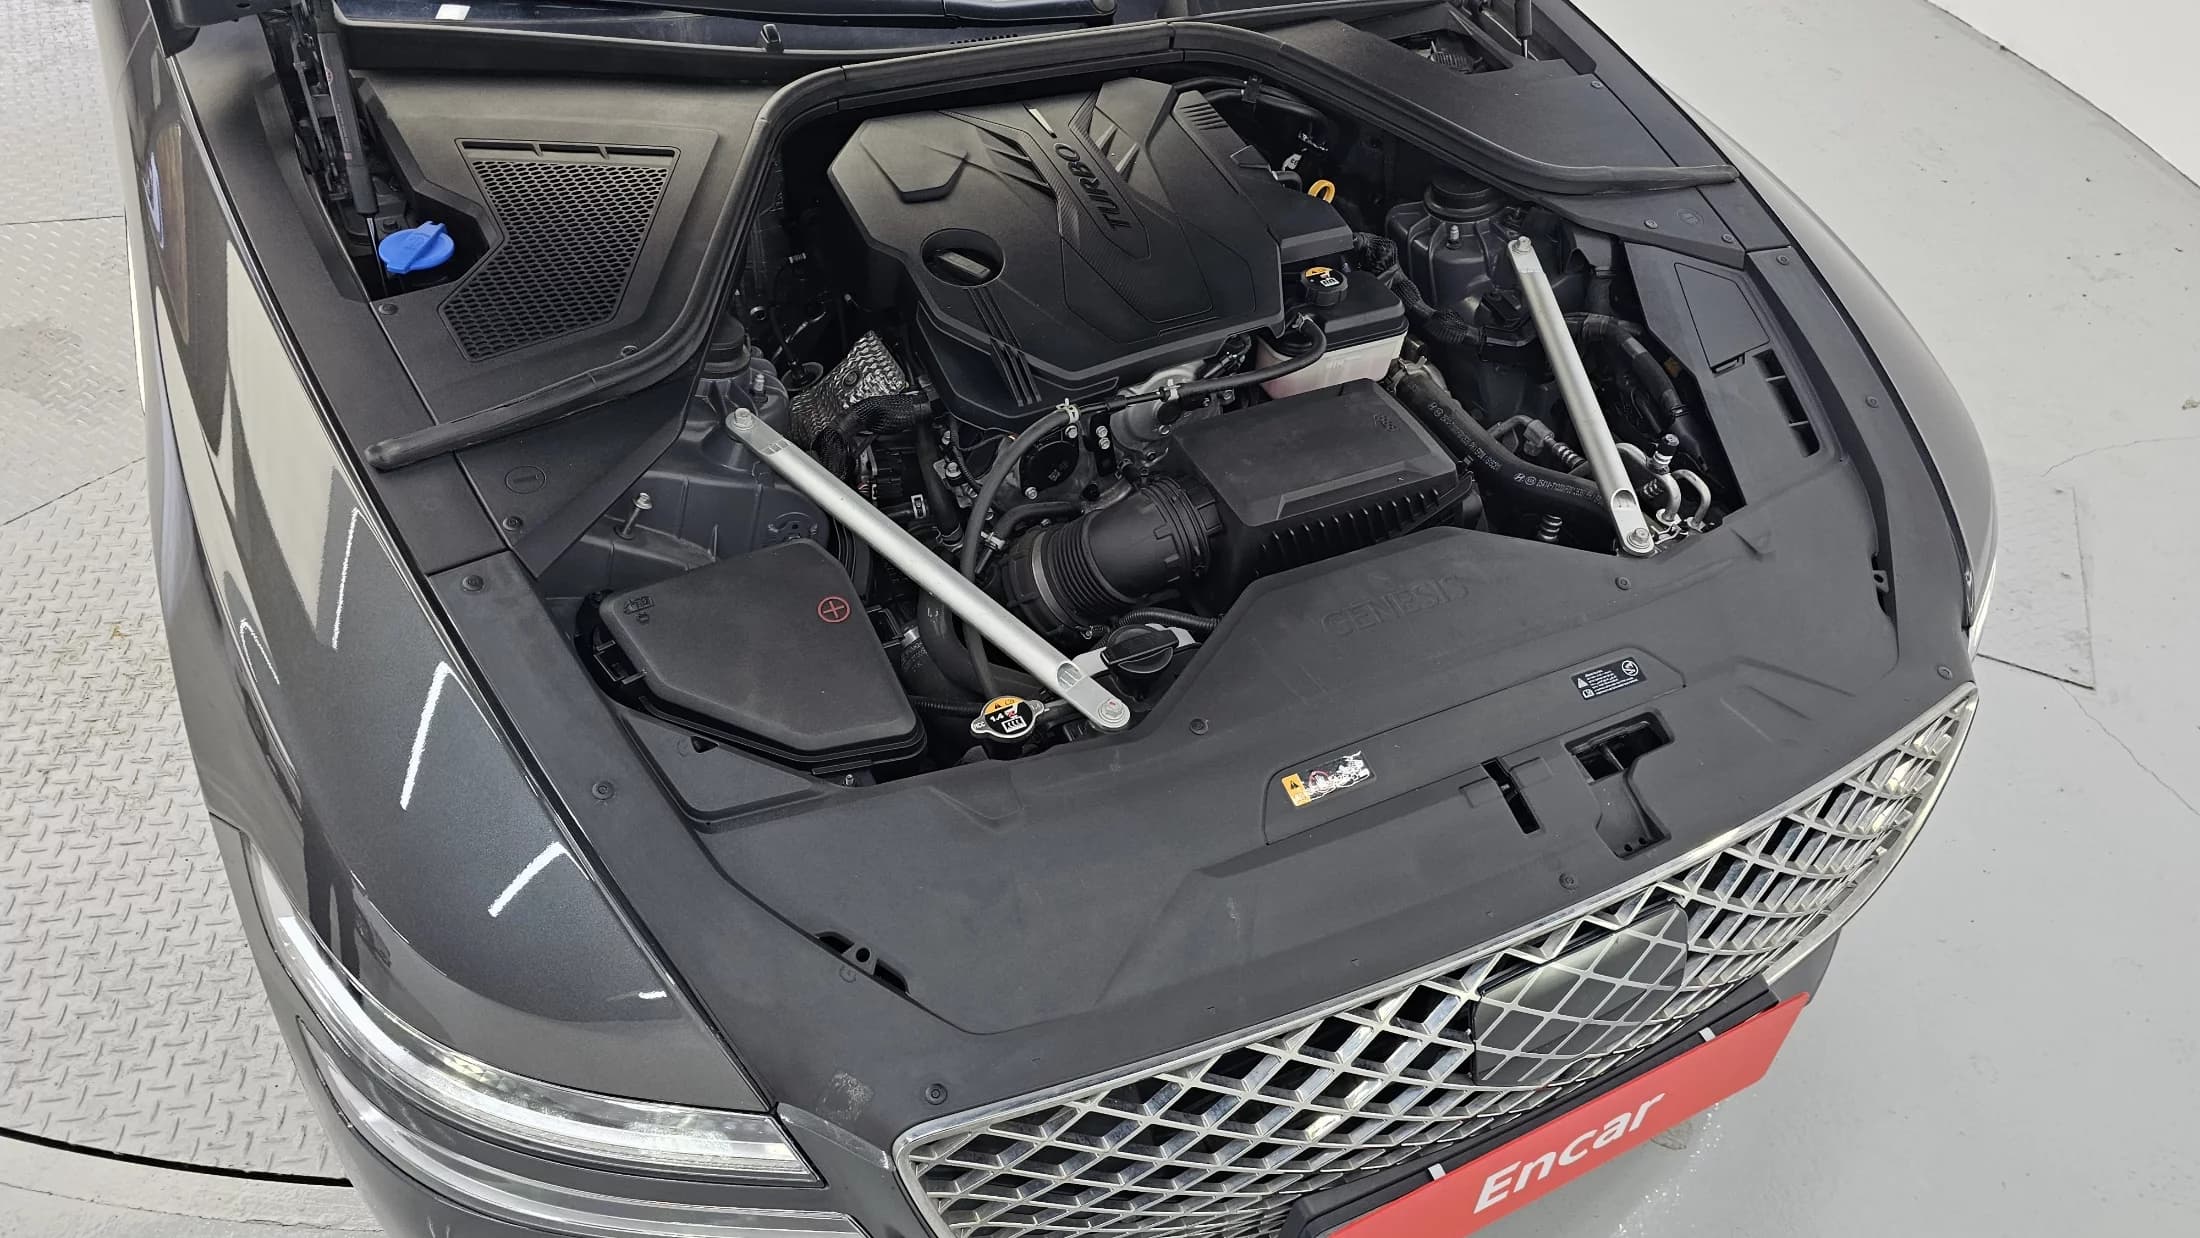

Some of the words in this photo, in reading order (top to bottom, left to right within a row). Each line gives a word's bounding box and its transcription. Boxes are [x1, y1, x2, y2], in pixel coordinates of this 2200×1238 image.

[1053, 142, 1132, 231] TURBO
[1320, 574, 1471, 637] GENESIS
[1473, 1093, 1665, 1214] Encar
